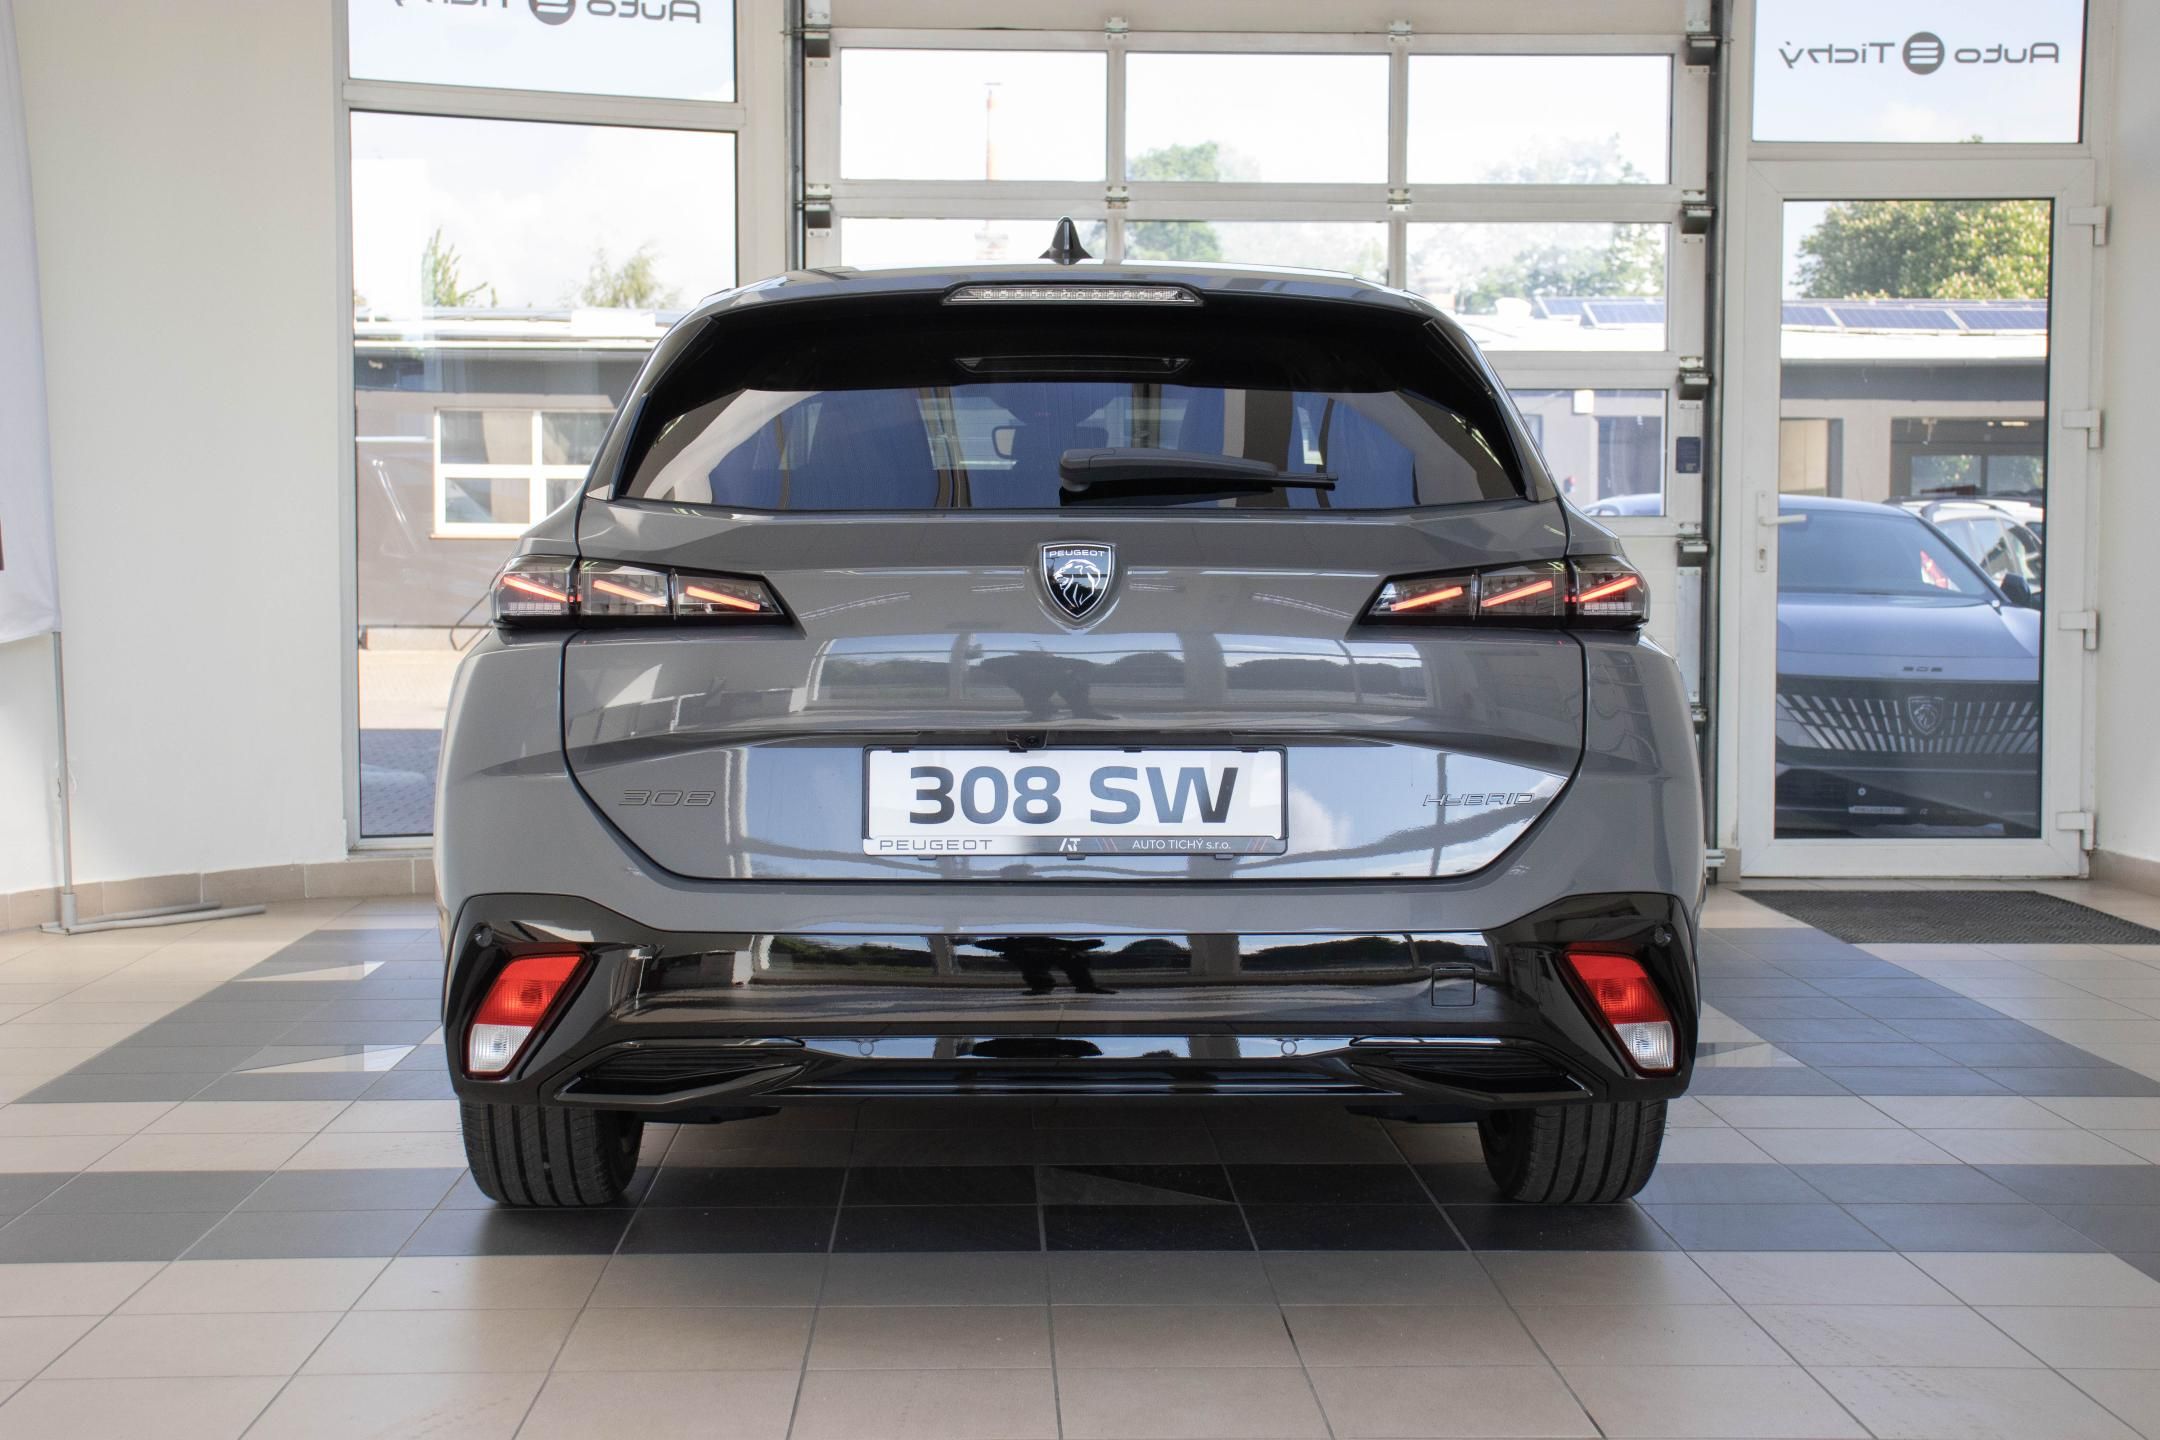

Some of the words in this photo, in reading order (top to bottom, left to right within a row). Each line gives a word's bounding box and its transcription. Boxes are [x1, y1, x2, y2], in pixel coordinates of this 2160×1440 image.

[1049, 549, 1105, 557] PEUGEOT
[618, 789, 716, 807] 308
[909, 765, 1061, 825] 308
[1089, 766, 1239, 825] SW
[1422, 792, 1535, 807] HYBRID
[879, 839, 993, 850] PEUGEOT
[1132, 839, 1166, 850] AUTO
[1168, 837, 1203, 849] TICHÝ
[1206, 841, 1231, 849] s.r.o.
